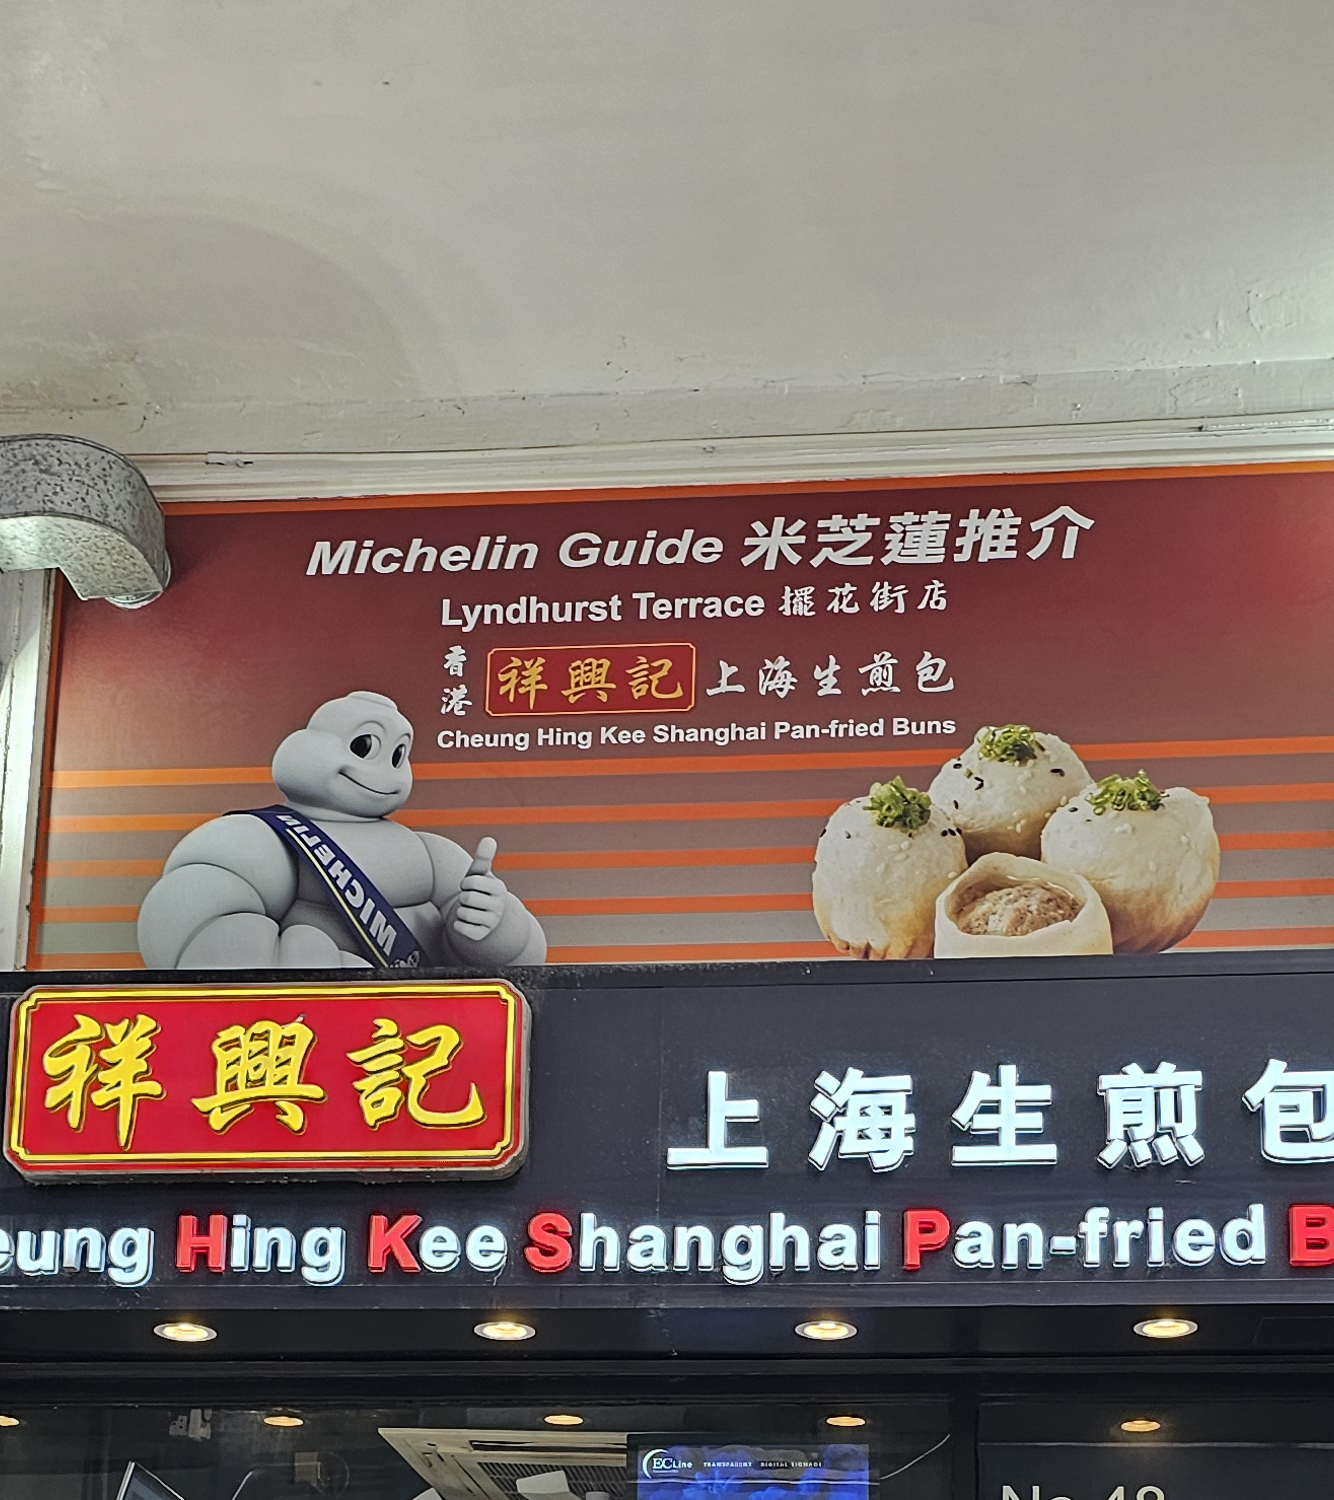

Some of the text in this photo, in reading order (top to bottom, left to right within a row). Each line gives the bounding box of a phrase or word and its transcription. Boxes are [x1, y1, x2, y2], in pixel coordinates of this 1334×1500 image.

[306, 529, 724, 577] Michelin Guide
[741, 506, 1095, 571] 米芝蓮推介
[441, 591, 766, 632] Lyndhurst Terrace
[778, 580, 950, 617] 擺花街店
[440, 645, 472, 718] 香港
[498, 654, 685, 710] 祥興記
[705, 649, 955, 699] 上海生煎包
[436, 716, 957, 751] Cheung Hing Kee Shanghai Pan-fried Buns
[276, 814, 399, 957] MICHELIN
[42, 1012, 490, 1152] 祥興記
[176, 1213, 346, 1285] Hing
[367, 1212, 509, 1273] Kee
[523, 1208, 882, 1286] Shanghai
[902, 1204, 1268, 1273] Pan-fried
